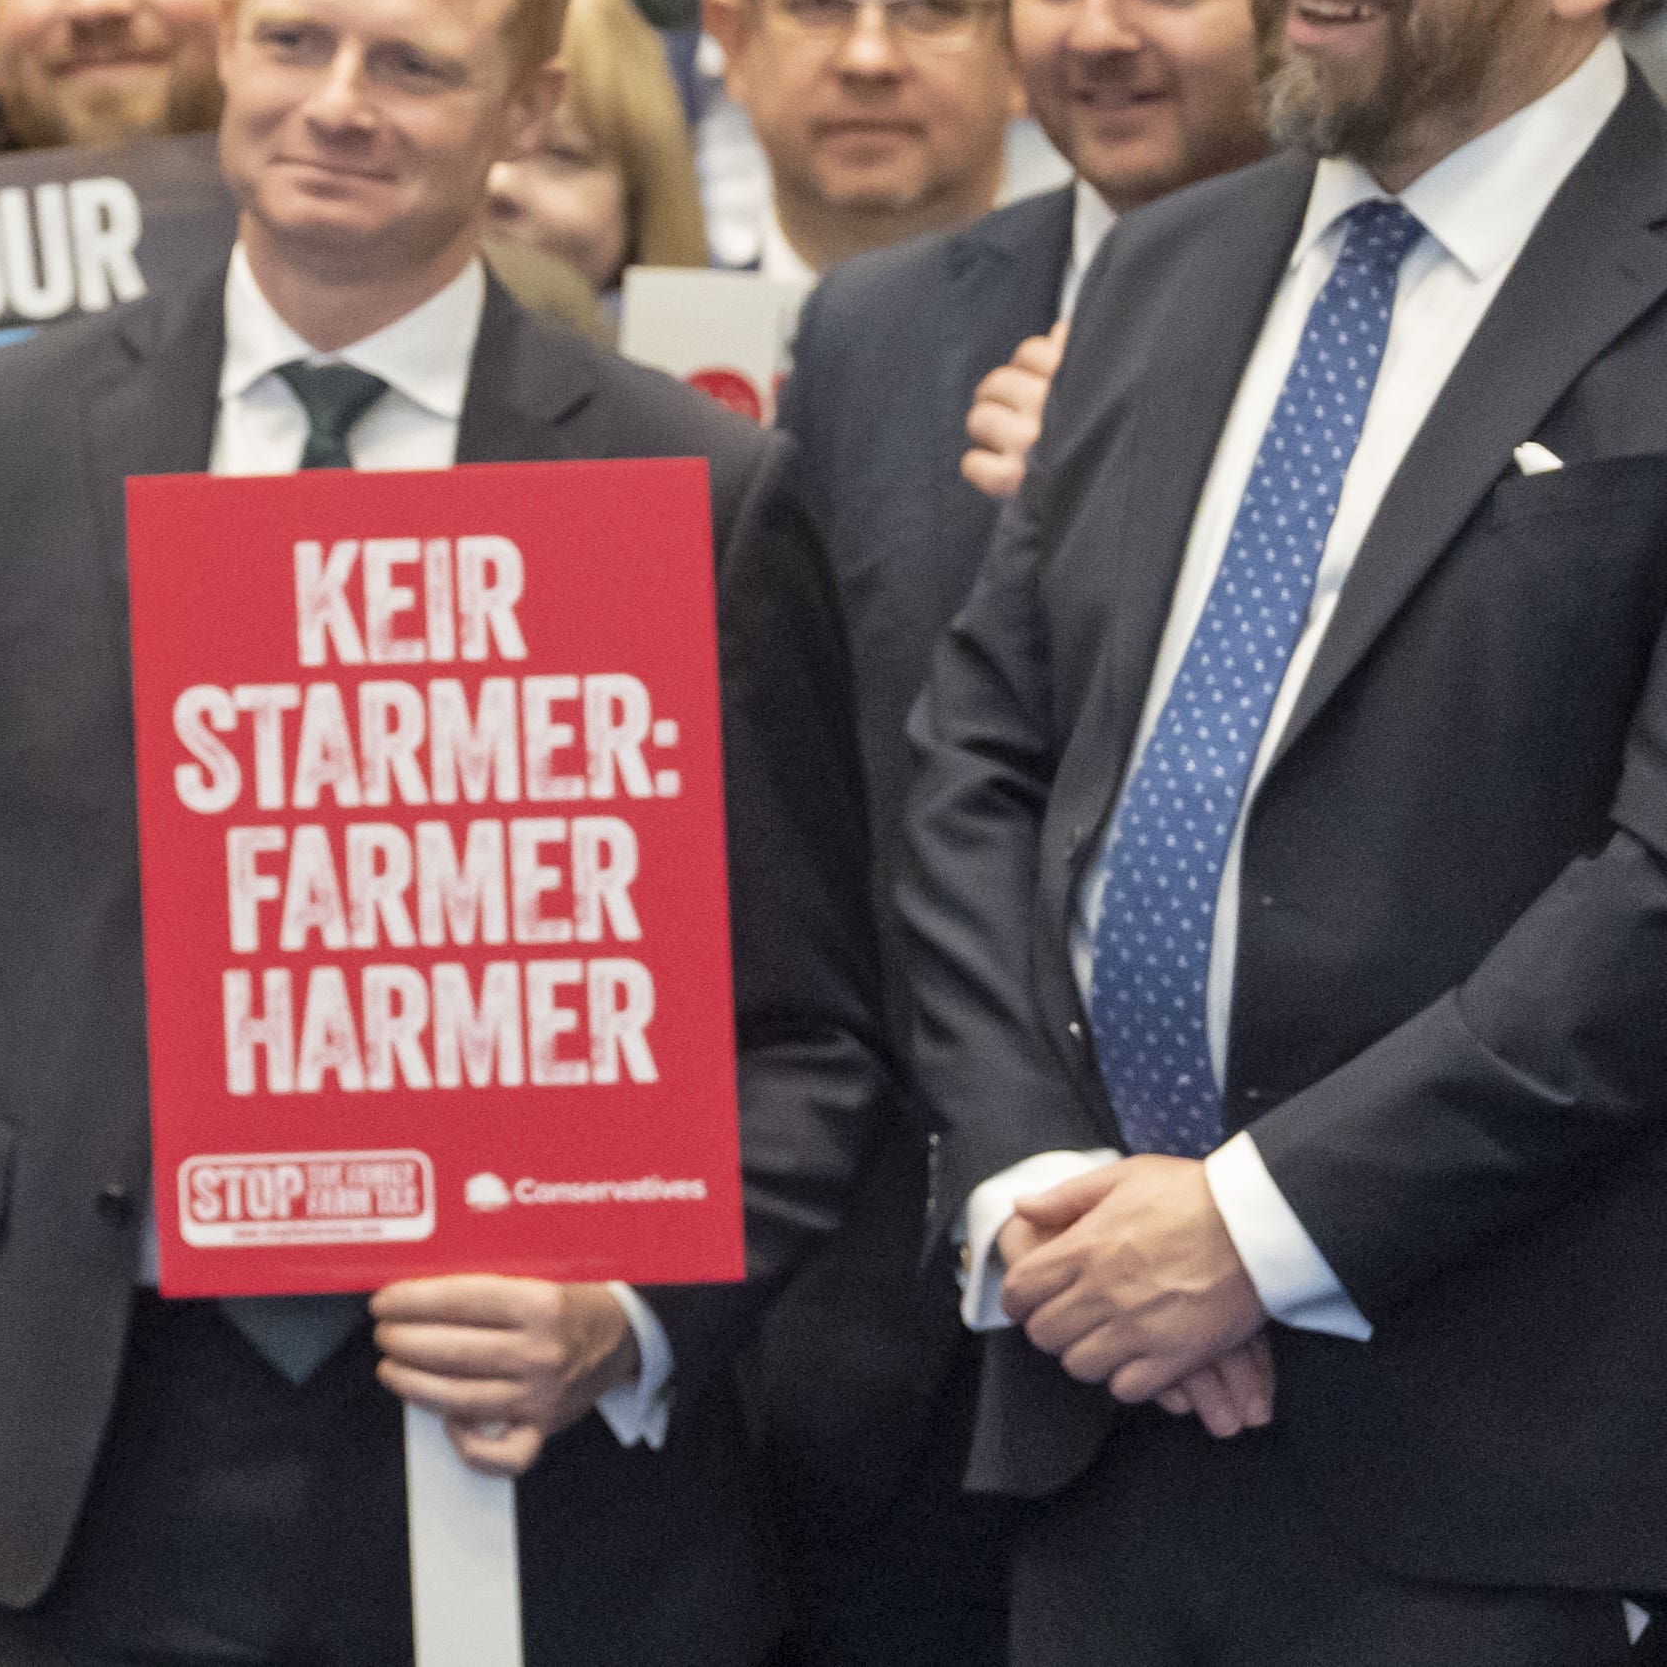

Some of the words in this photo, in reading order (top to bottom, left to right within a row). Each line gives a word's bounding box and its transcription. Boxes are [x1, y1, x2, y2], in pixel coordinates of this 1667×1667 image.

[293, 535, 528, 668] KEIR
[171, 672, 683, 815] STARMER:
[224, 816, 643, 954] FARMER
[220, 957, 660, 1096] HARMER
[191, 1165, 305, 1221] STOP
[513, 1175, 708, 1205] Conservatives
